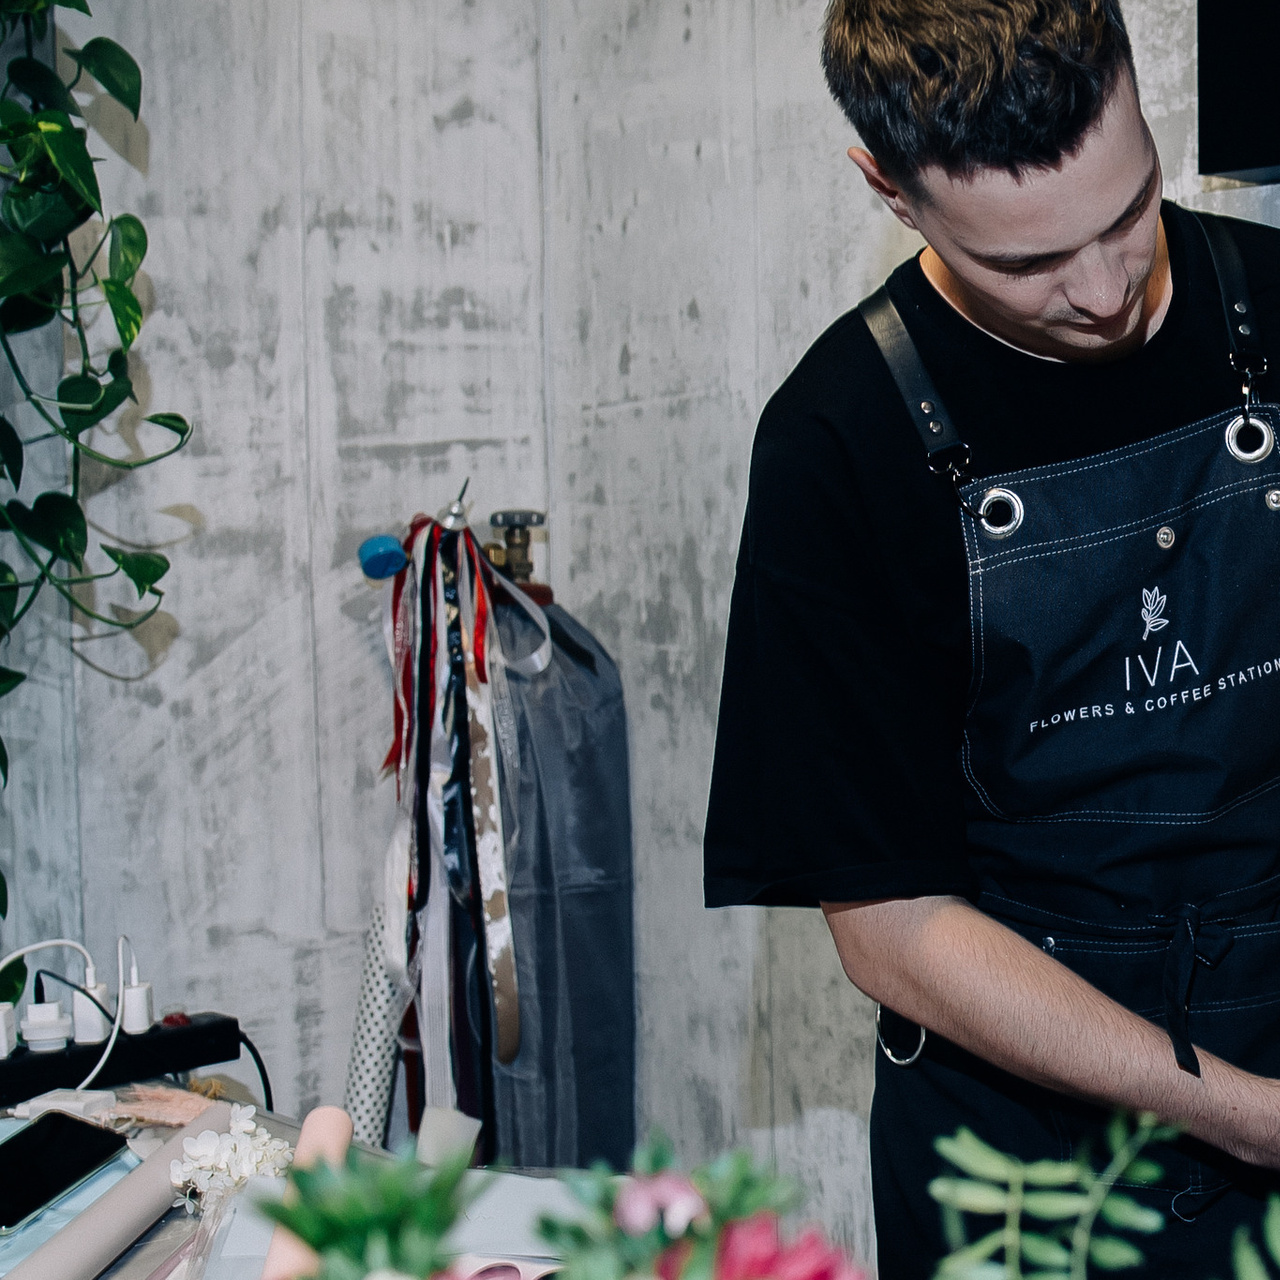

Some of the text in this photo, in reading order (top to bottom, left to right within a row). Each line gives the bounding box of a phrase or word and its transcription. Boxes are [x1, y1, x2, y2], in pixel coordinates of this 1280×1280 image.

[1124, 639, 1200, 691] IVA
[1029, 703, 1116, 733] FLOWERS
[1124, 701, 1136, 715] &
[1144, 683, 1213, 713] COFFEE
